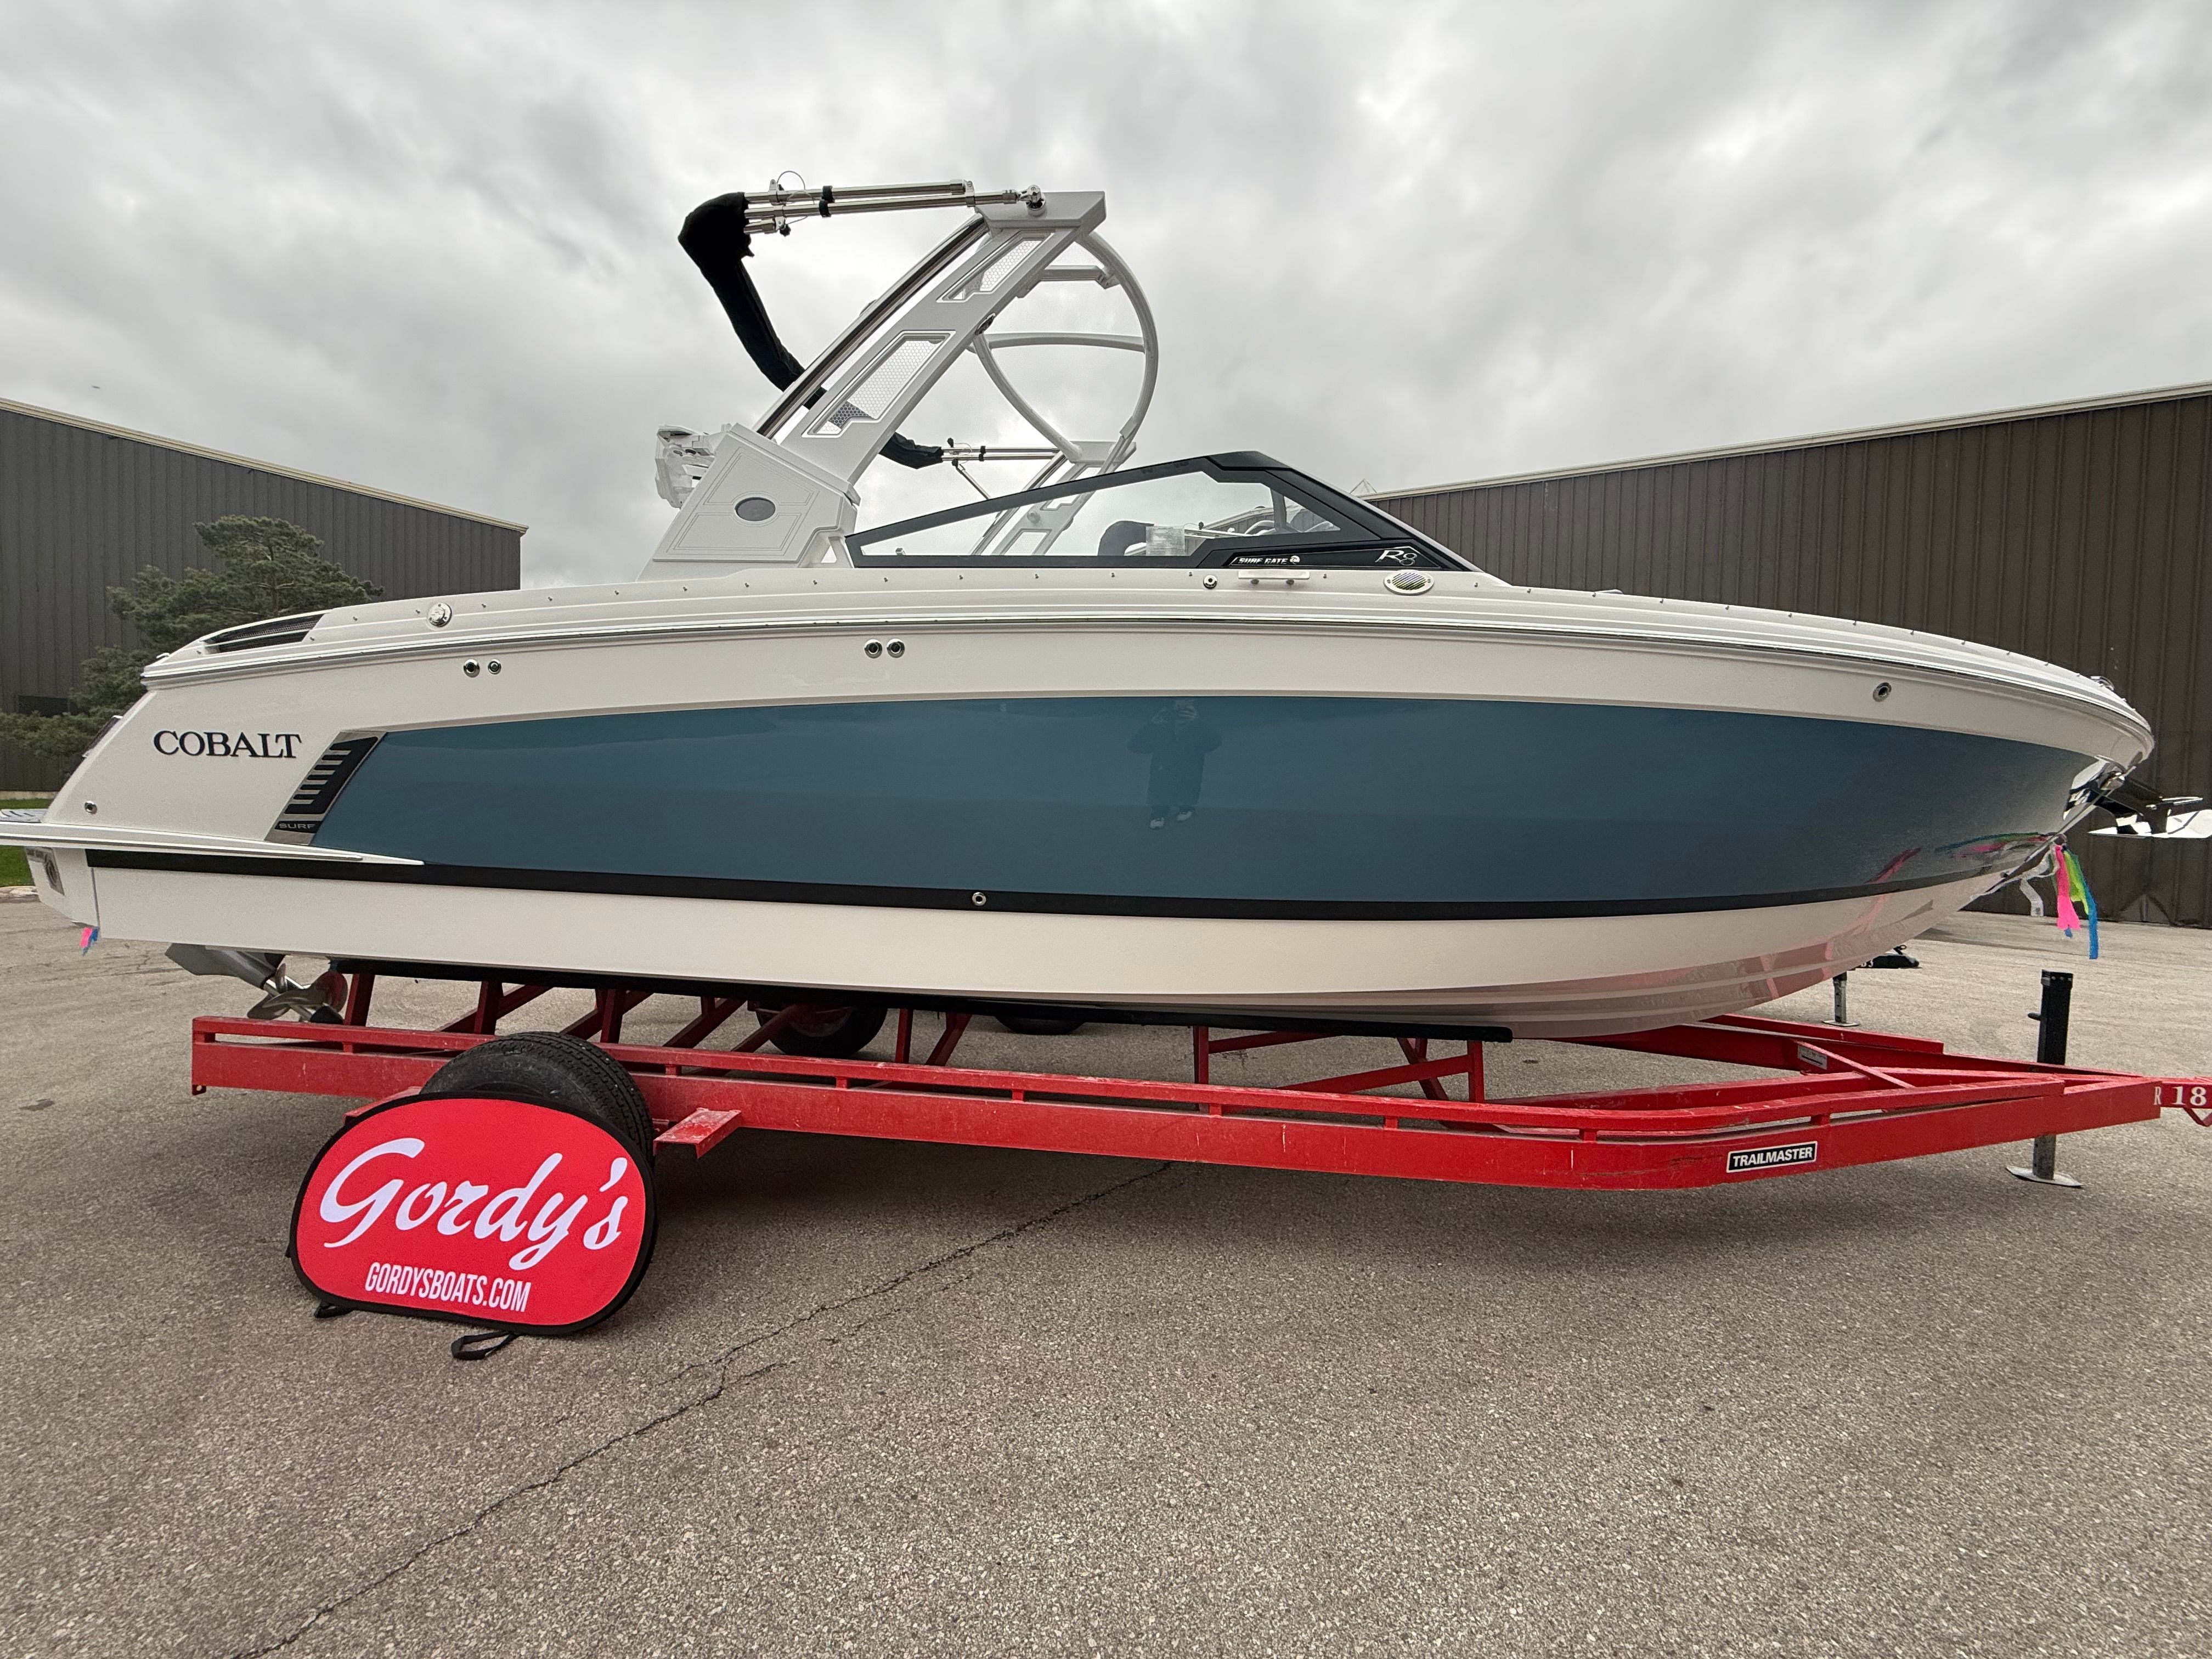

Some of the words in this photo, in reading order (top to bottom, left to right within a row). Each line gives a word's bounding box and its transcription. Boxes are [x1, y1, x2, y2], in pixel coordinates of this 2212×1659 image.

[1374, 550, 1418, 566] R8
[153, 730, 302, 758] COBALT
[2153, 1086, 2162, 1105] R
[2170, 1085, 2207, 1106] 18
[1733, 1147, 1813, 1167] TRAILMASTER
[320, 1137, 628, 1270] Gordy's
[364, 1262, 532, 1312] GORDYSBOATS.COM
